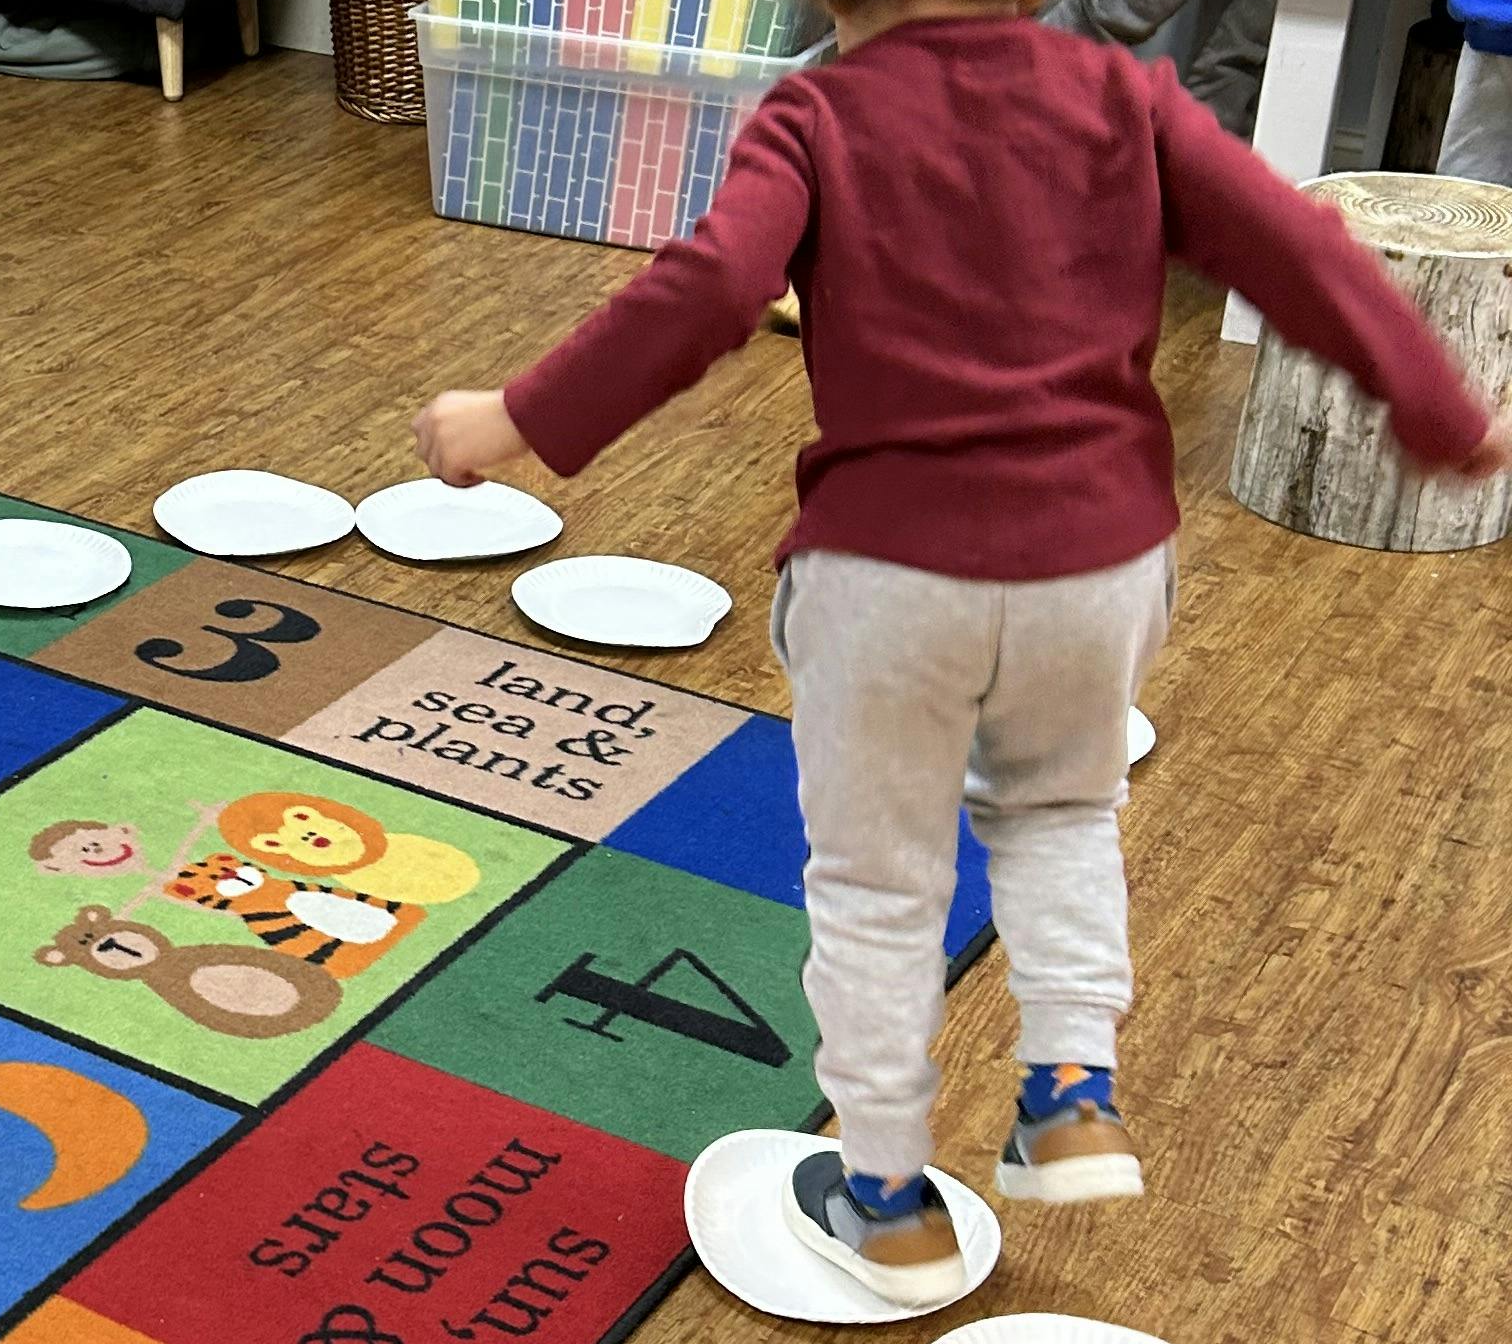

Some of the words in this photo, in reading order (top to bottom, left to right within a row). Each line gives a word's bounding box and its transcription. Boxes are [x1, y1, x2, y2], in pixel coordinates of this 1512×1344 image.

[133, 598, 322, 684] 3
[412, 690, 537, 740] sea
[555, 728, 635, 767] &
[473, 659, 656, 740] land,
[351, 715, 605, 802] plants
[533, 947, 794, 1069] 4
[248, 1140, 421, 1279] stars
[365, 1138, 562, 1295] moon
[440, 1226, 612, 1341] sun,
